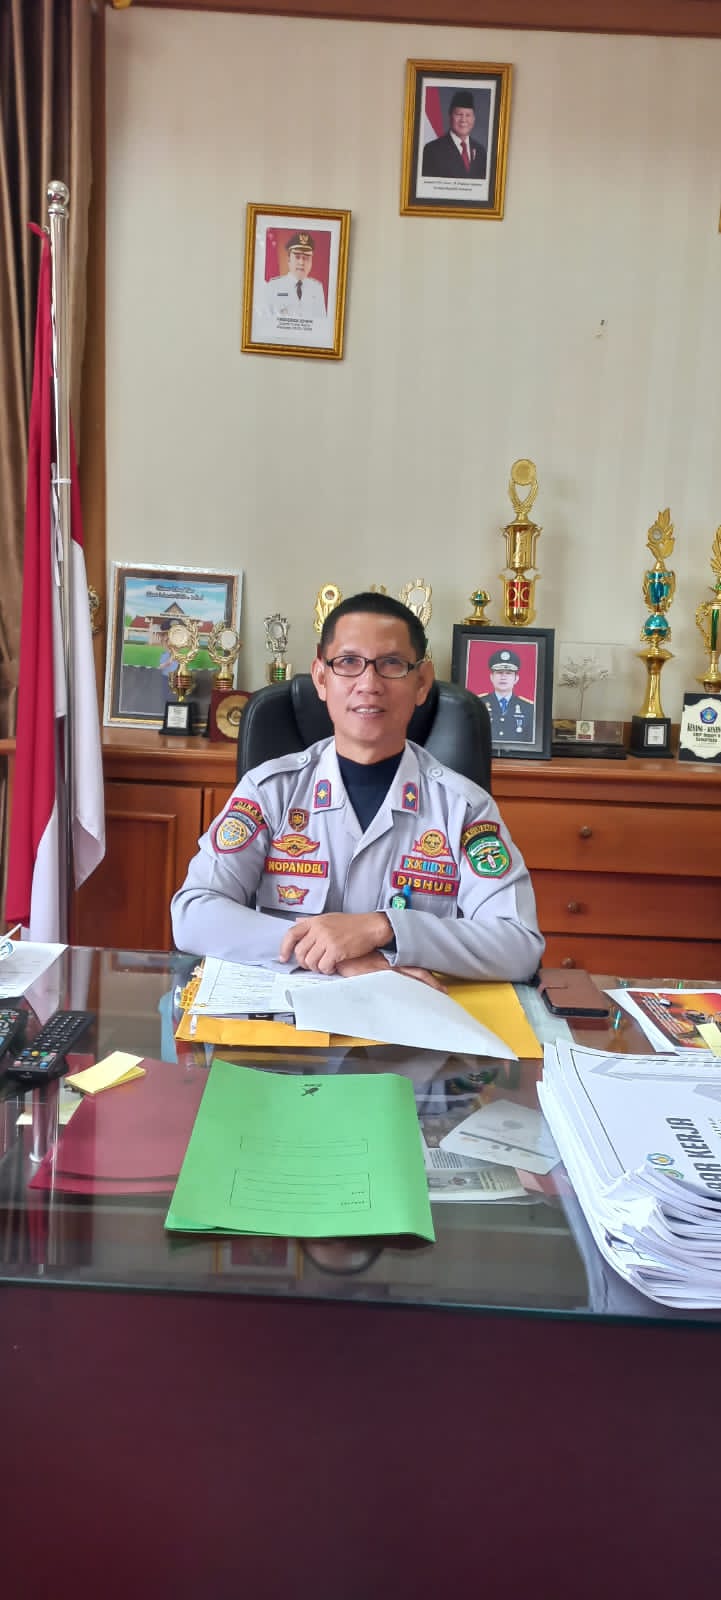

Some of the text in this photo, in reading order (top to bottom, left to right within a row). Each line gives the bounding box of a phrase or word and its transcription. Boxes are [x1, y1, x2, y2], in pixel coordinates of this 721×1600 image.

[268, 860, 323, 874] NOPANDEL
[397, 875, 453, 893] DISHUB
[665, 1117, 721, 1192] BAR KERJA
